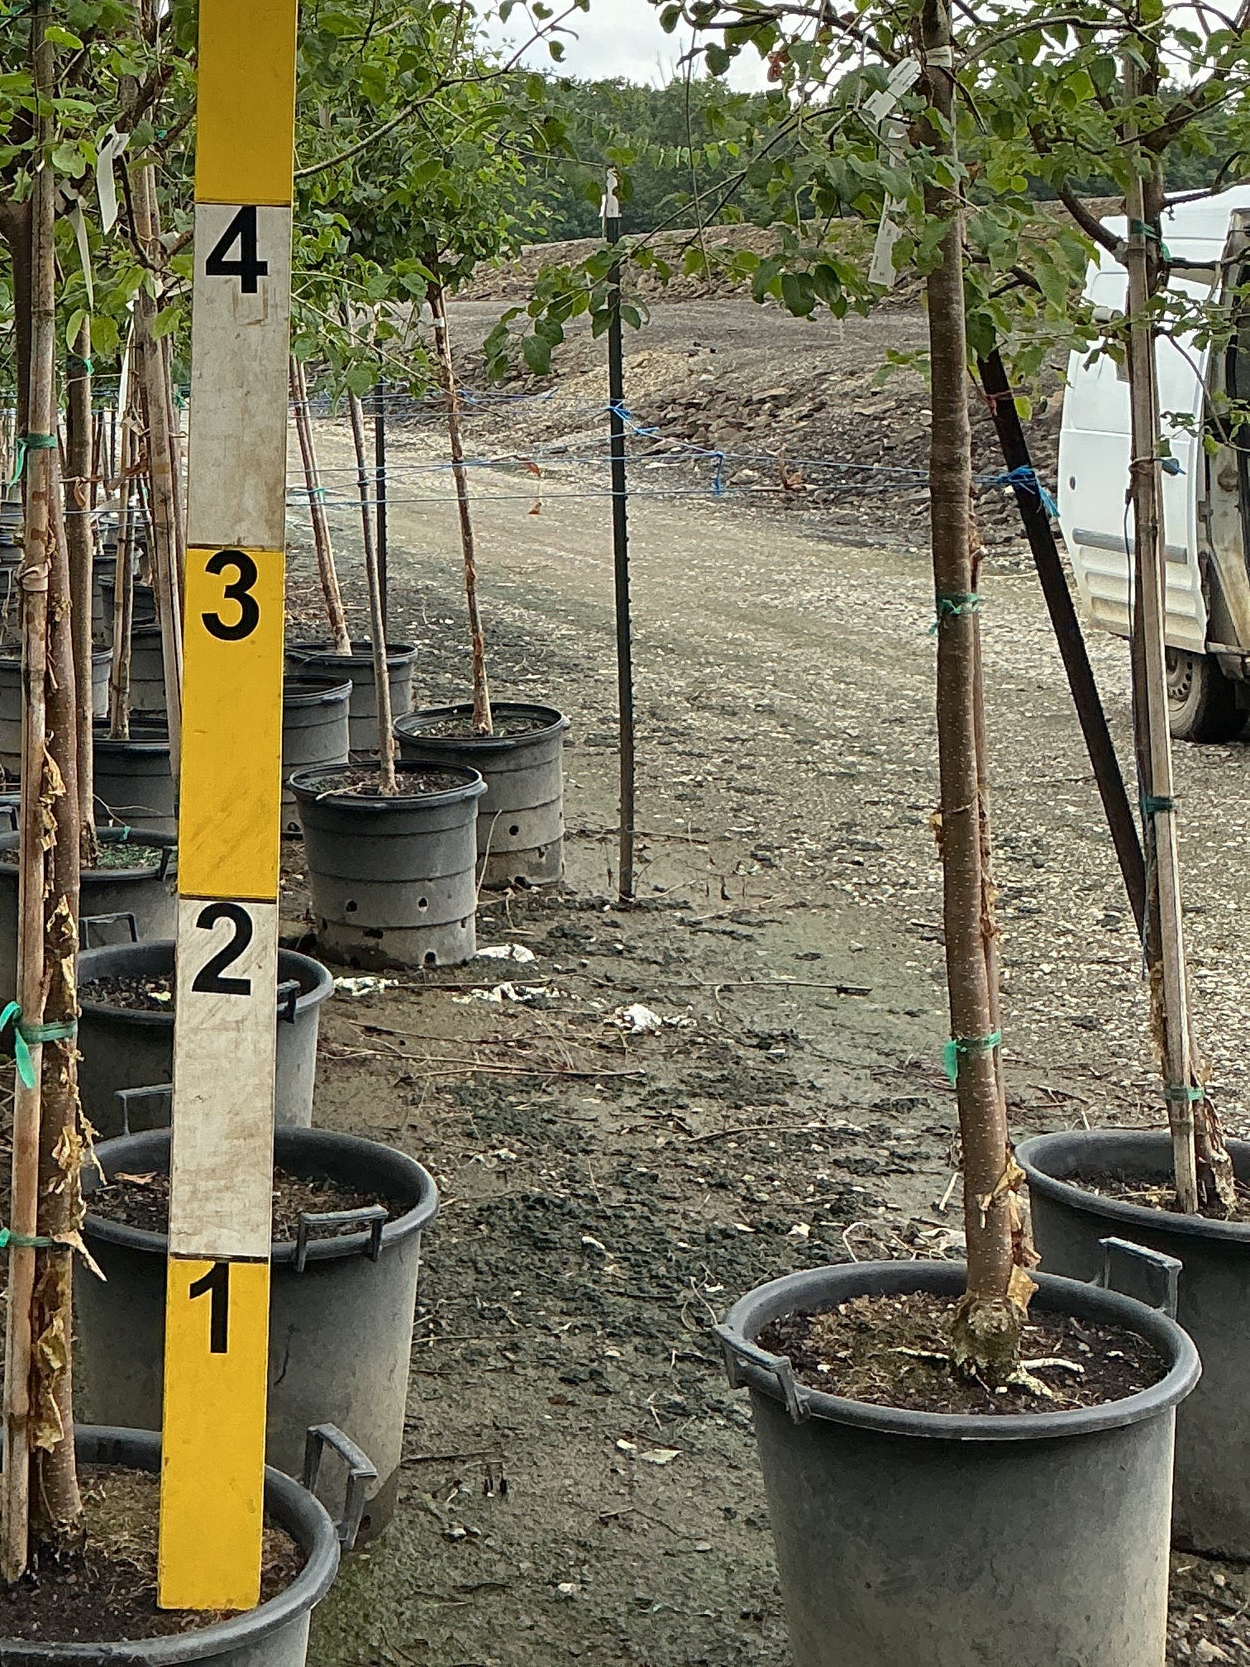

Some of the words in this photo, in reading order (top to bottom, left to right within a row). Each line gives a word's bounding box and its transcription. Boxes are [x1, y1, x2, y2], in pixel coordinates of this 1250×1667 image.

[205, 206, 268, 293] 4
[201, 550, 259, 641] 3
[191, 903, 253, 995] 2
[188, 1264, 230, 1354] 1
